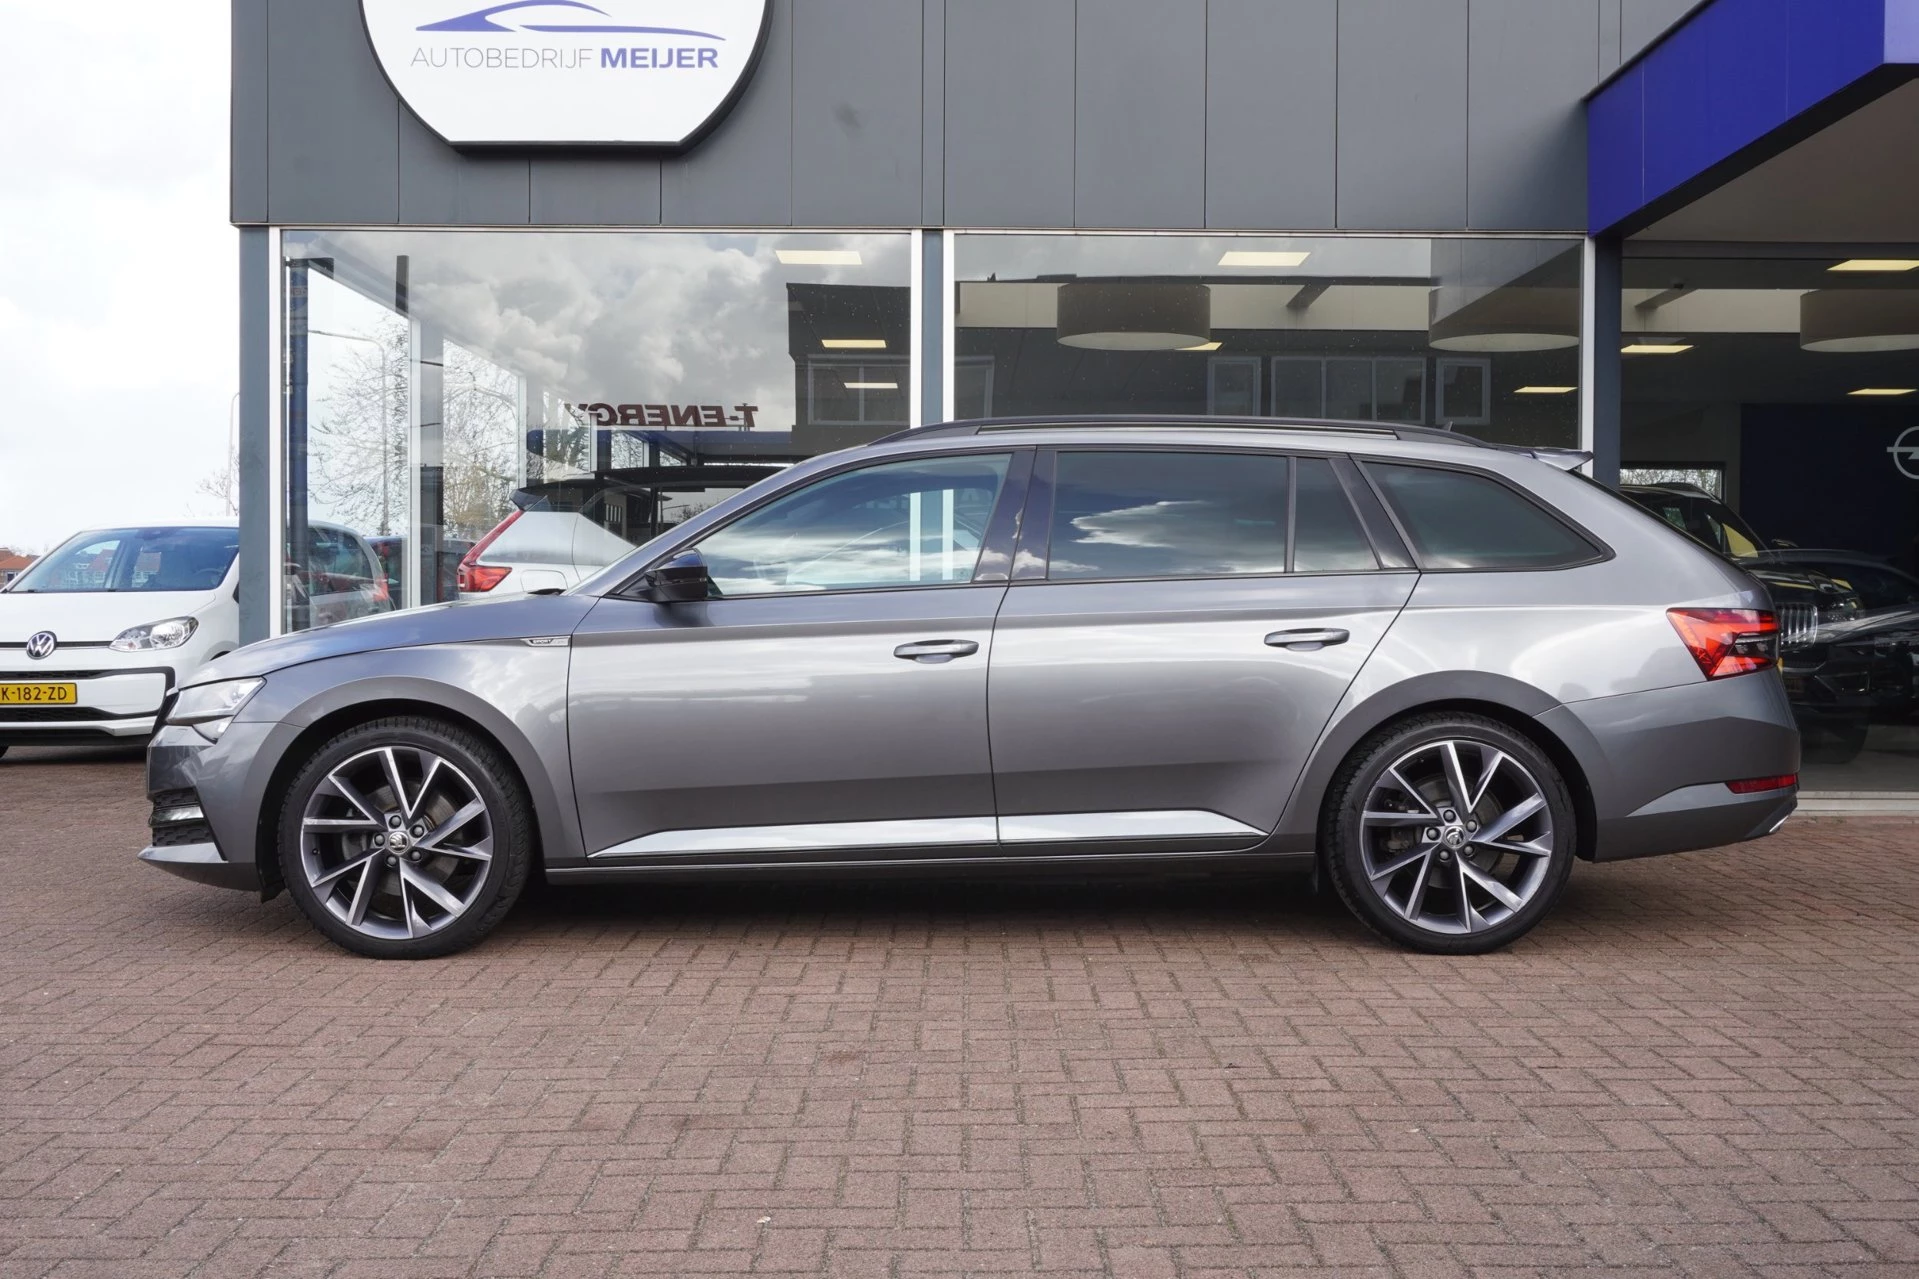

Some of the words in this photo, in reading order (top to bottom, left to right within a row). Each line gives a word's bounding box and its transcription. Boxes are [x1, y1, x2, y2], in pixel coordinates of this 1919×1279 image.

[410, 47, 594, 69] AUTOBEDRIJF
[600, 47, 719, 69] MEIJER
[1, 686, 67, 701] K-182-ZD
